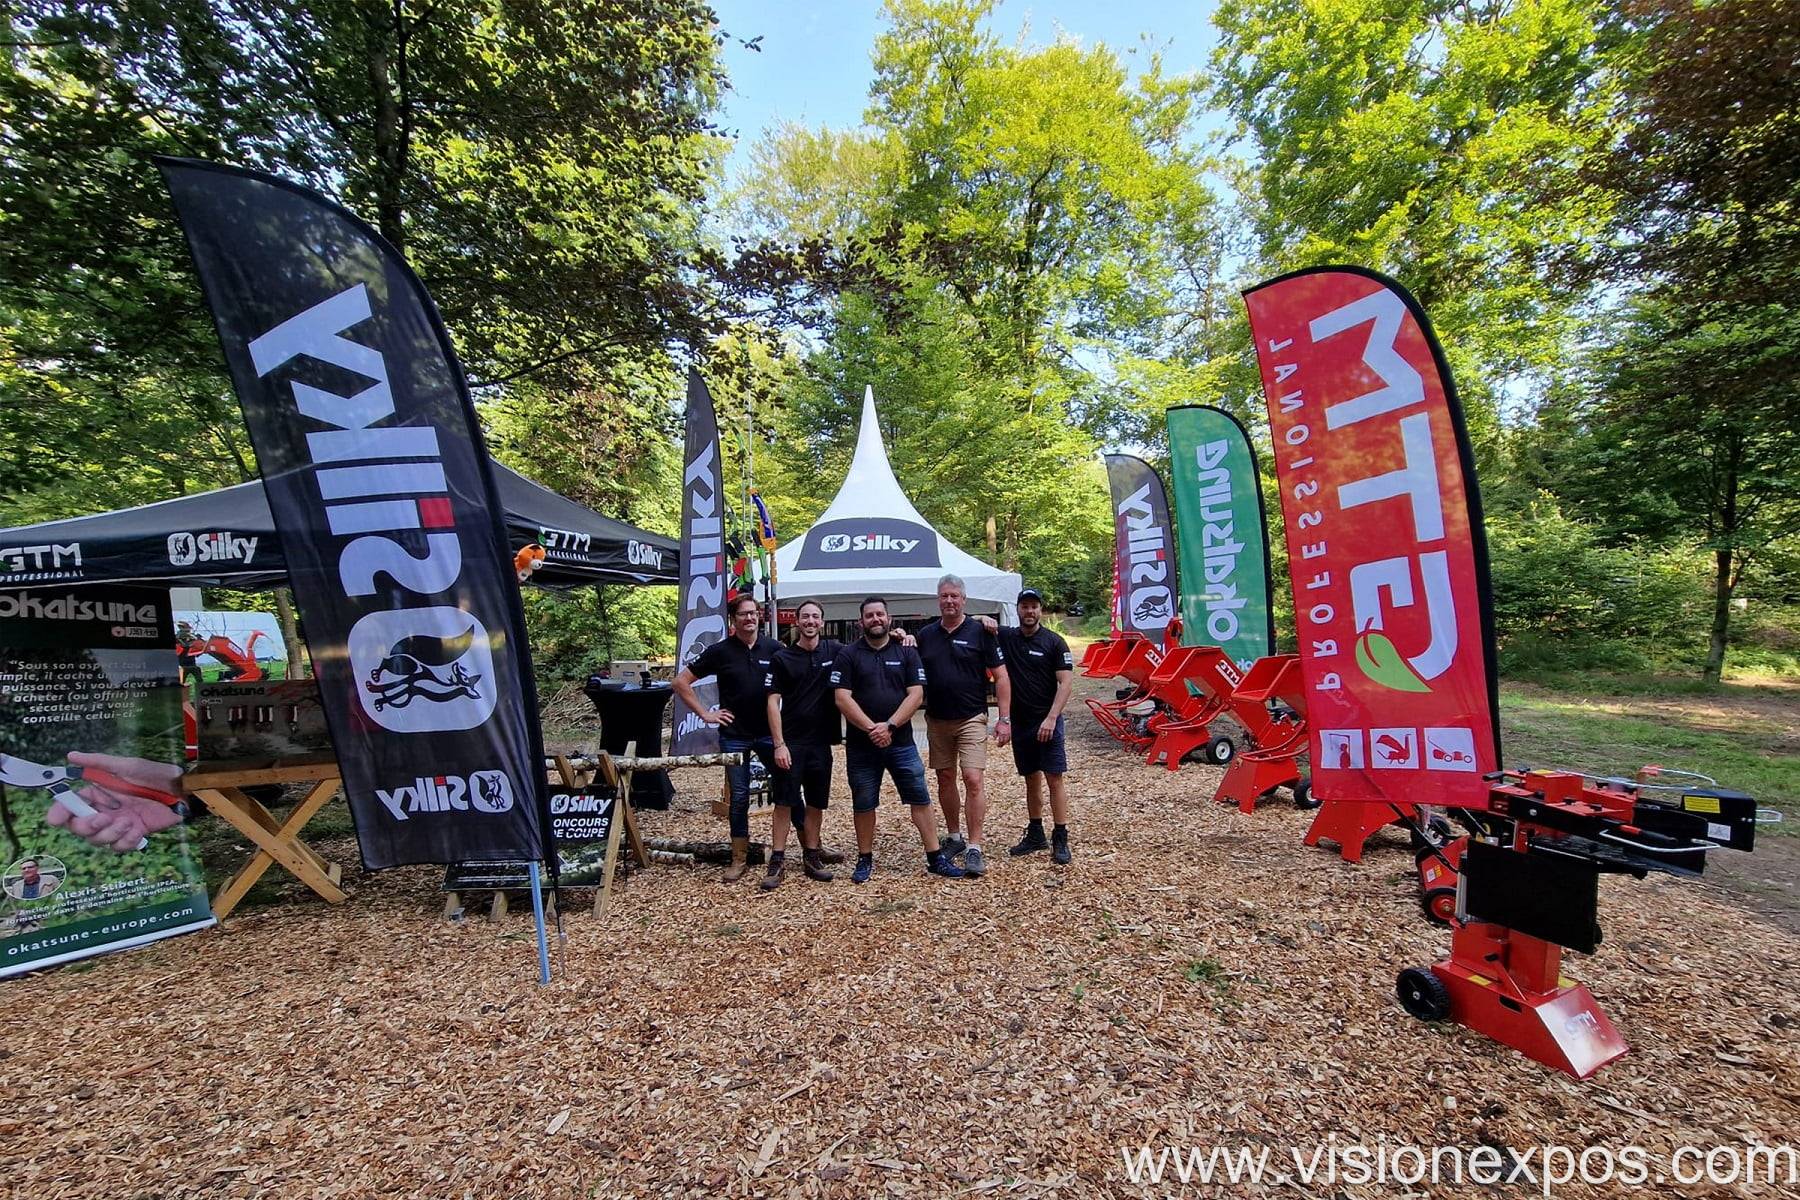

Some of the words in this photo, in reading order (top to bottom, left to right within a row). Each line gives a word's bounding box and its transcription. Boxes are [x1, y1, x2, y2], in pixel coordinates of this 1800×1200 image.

[199, 532, 258, 564] Silky
[853, 532, 920, 553] Silky
[0, 543, 82, 572] GTM
[639, 543, 662, 570] Silky
[44, 672, 54, 681] il
[57, 672, 93, 681] cache
[2, 682, 71, 694] puissance.
[75, 681, 87, 691] Si
[90, 682, 121, 690] vous
[123, 680, 158, 689] devez
[14, 693, 67, 703] acheter
[68, 691, 90, 703] (ou
[93, 690, 129, 702] offrir)
[132, 690, 148, 698] un
[29, 702, 88, 713] sécateur,
[91, 701, 103, 712] je
[107, 701, 135, 710] vous
[22, 711, 82, 725] conseille
[568, 794, 613, 815] Silky
[553, 817, 609, 828] ONCOURS
[566, 828, 606, 839] COUPE
[55, 883, 98, 902] Alexis
[100, 877, 147, 894] Stibert
[7, 906, 194, 956] okatsune-europe.com
